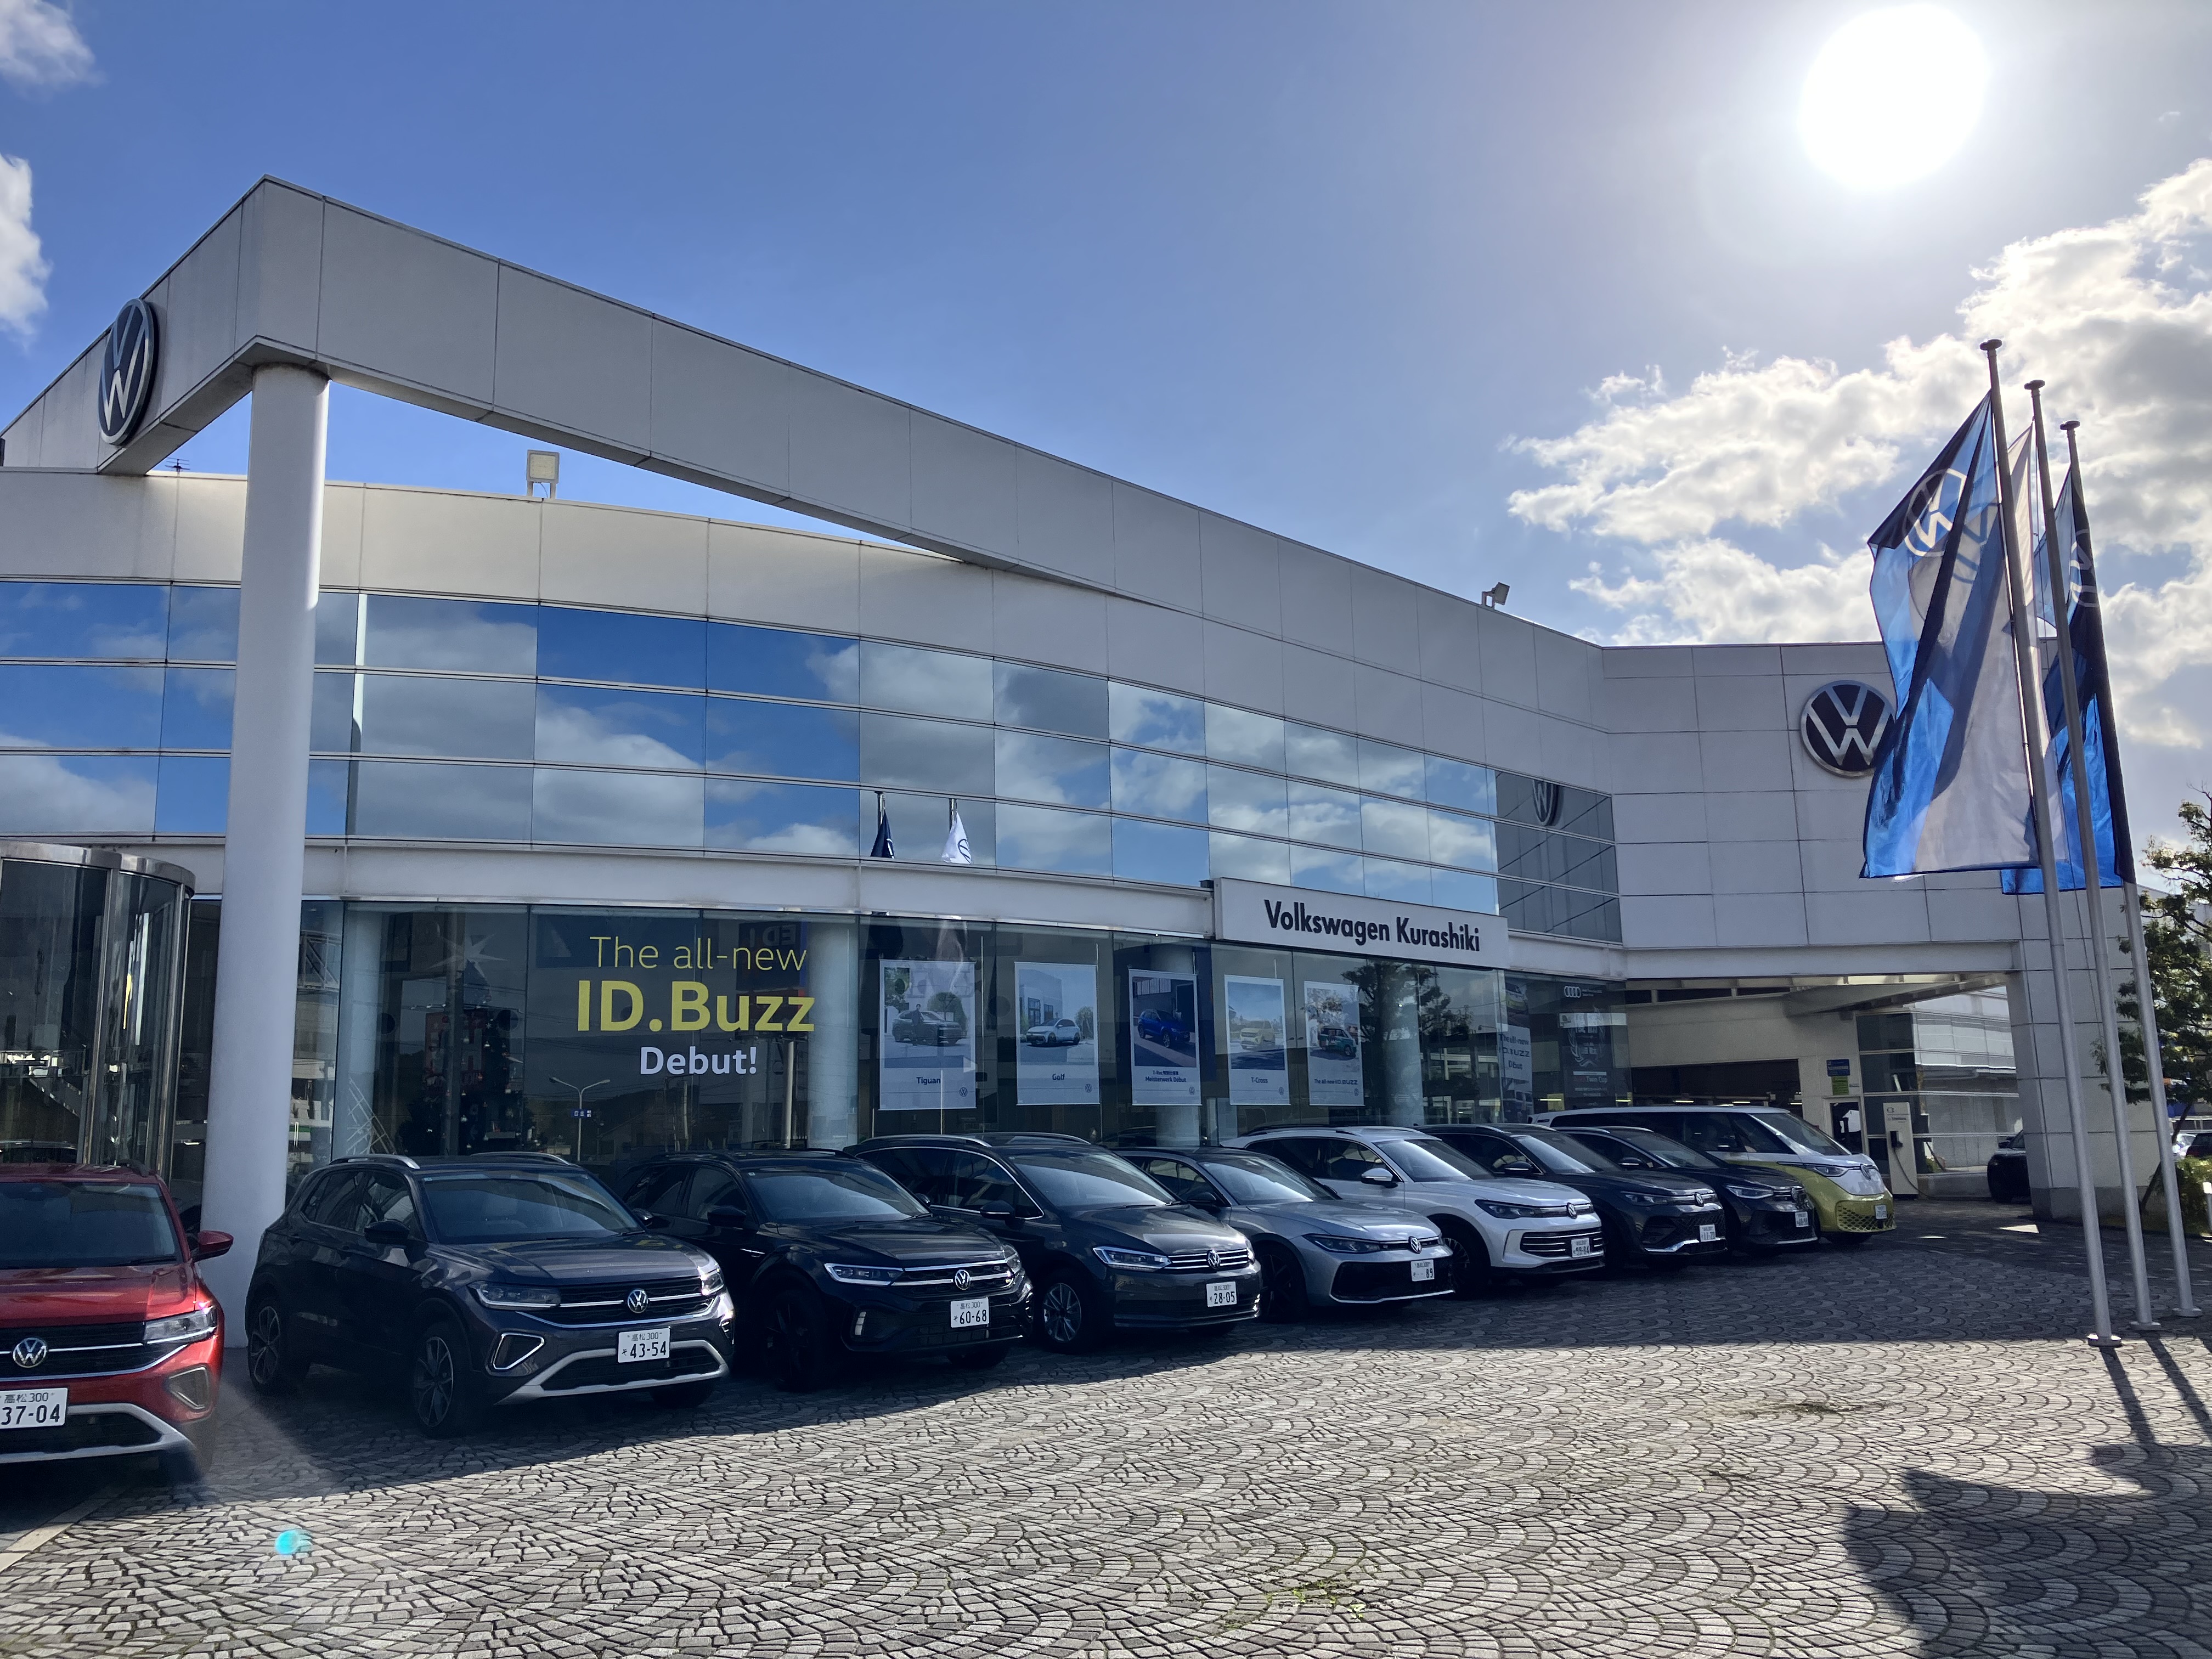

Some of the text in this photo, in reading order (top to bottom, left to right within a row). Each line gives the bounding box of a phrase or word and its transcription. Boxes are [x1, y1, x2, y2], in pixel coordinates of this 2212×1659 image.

[1265, 900, 1480, 952] Volkswagen Kurashiki
[590, 936, 807, 972] The all-new
[578, 980, 815, 1032] ID.Buzz
[640, 1046, 757, 1076] Debut!
[916, 1077, 941, 1085] Tiguan
[1214, 1291, 1235, 1304] 28-05
[1, 1404, 60, 1425] 37-04
